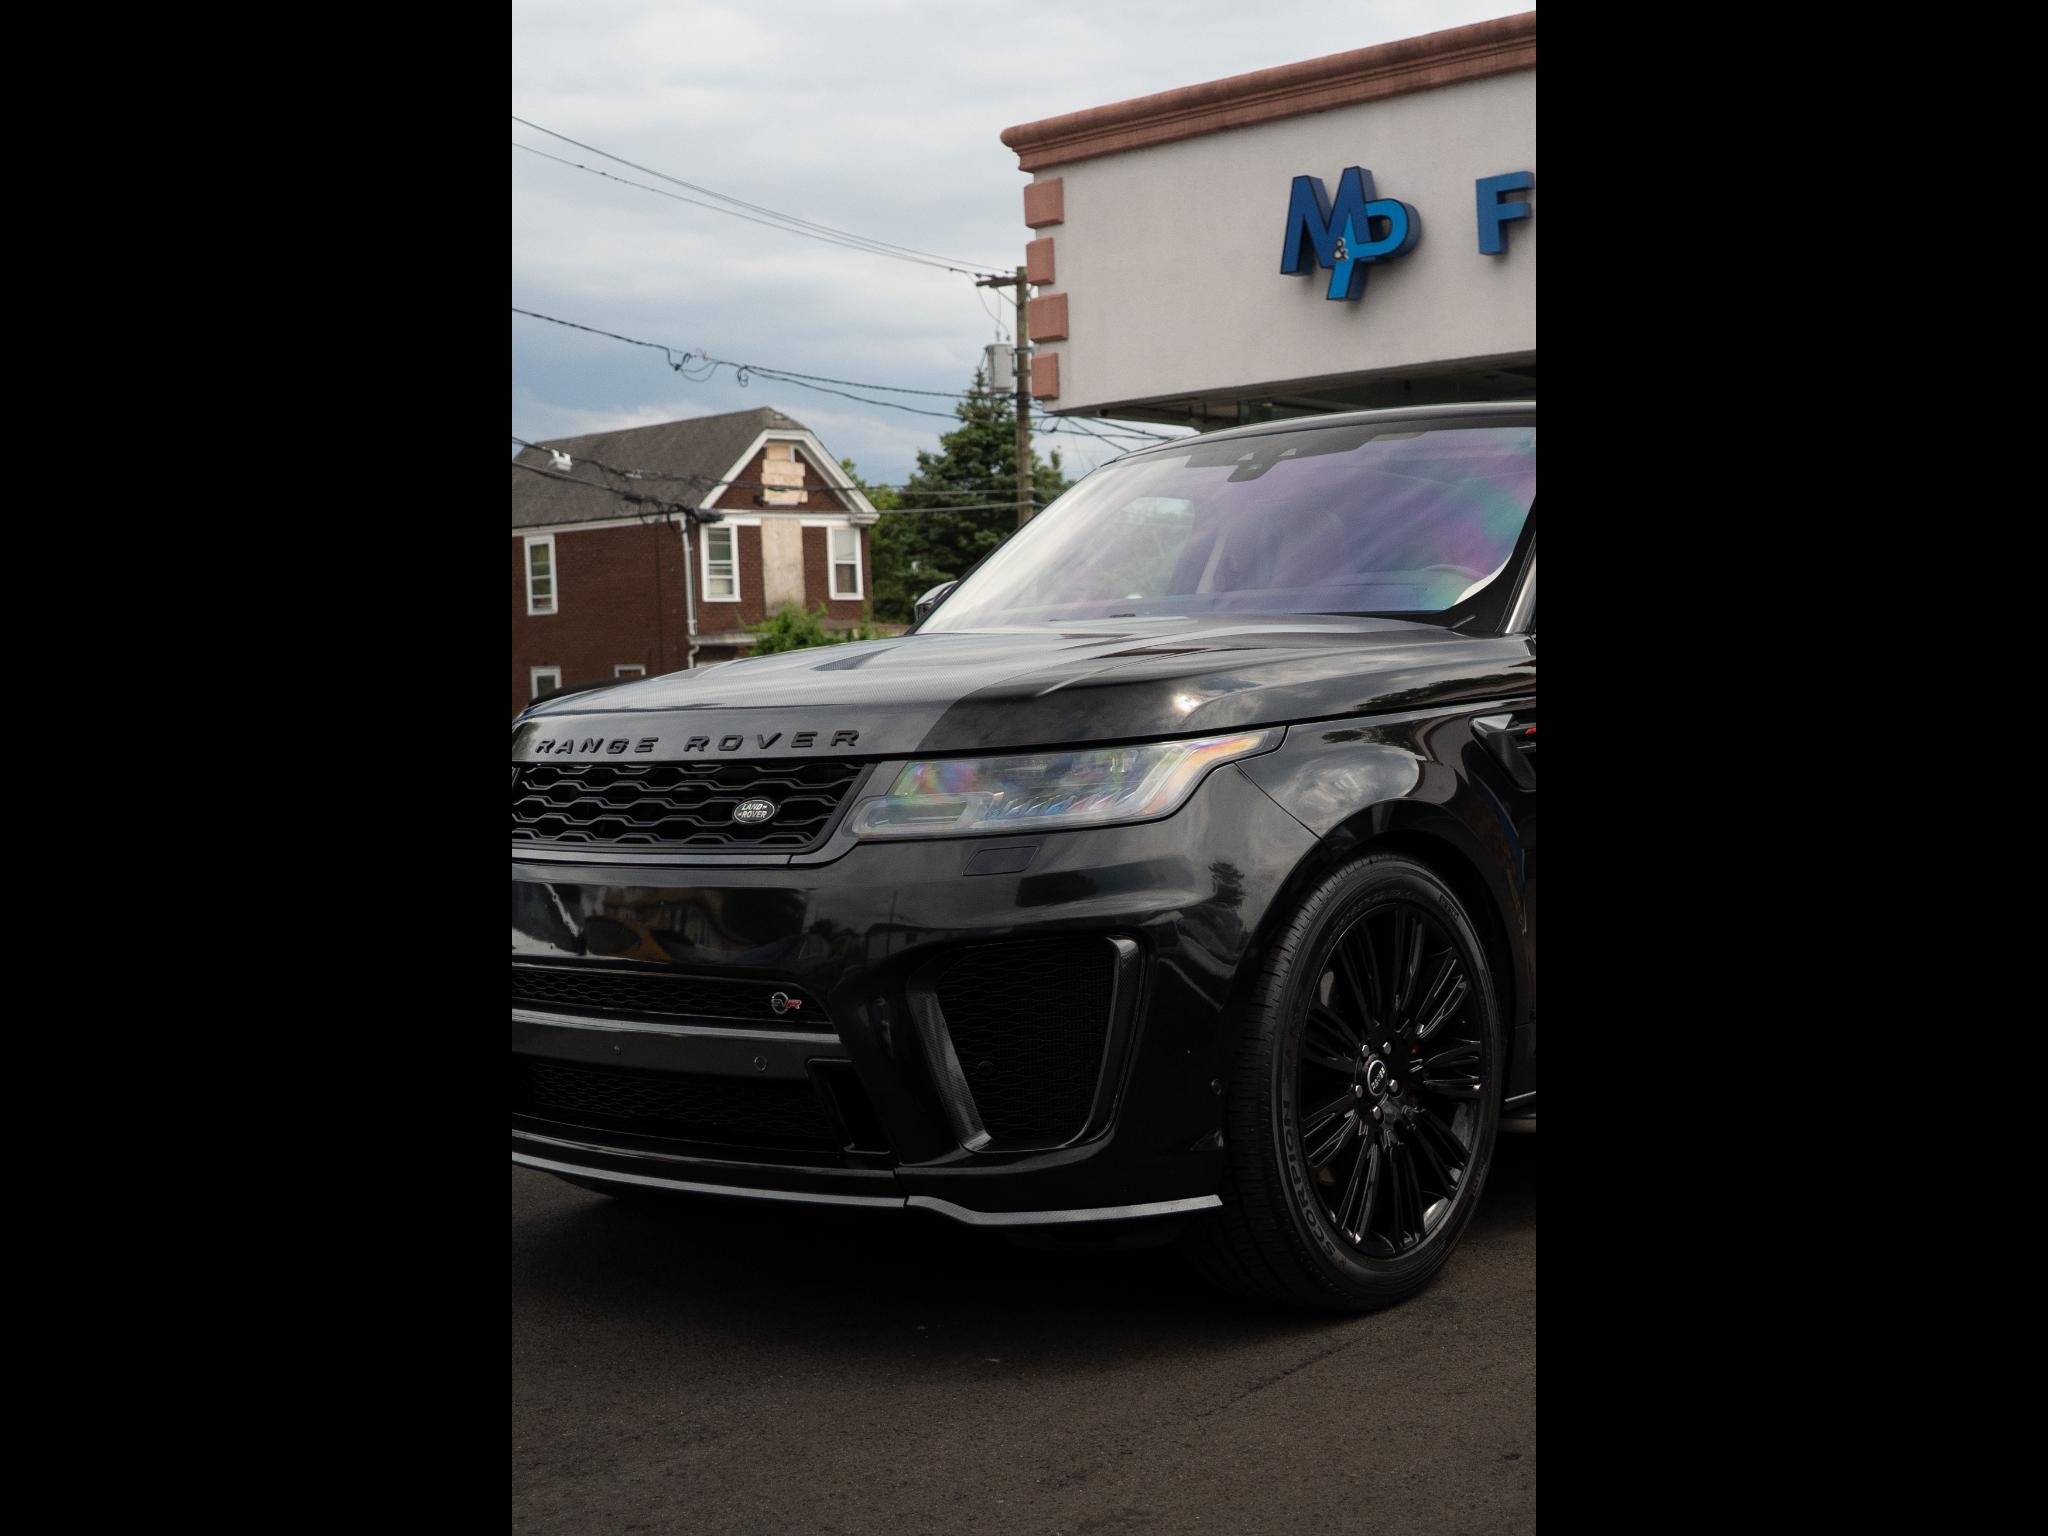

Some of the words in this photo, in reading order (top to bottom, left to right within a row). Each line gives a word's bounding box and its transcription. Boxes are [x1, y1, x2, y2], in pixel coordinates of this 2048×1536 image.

[1475, 170, 1536, 256] F
[534, 736, 659, 754] RANGE
[683, 729, 860, 752] ROVER
